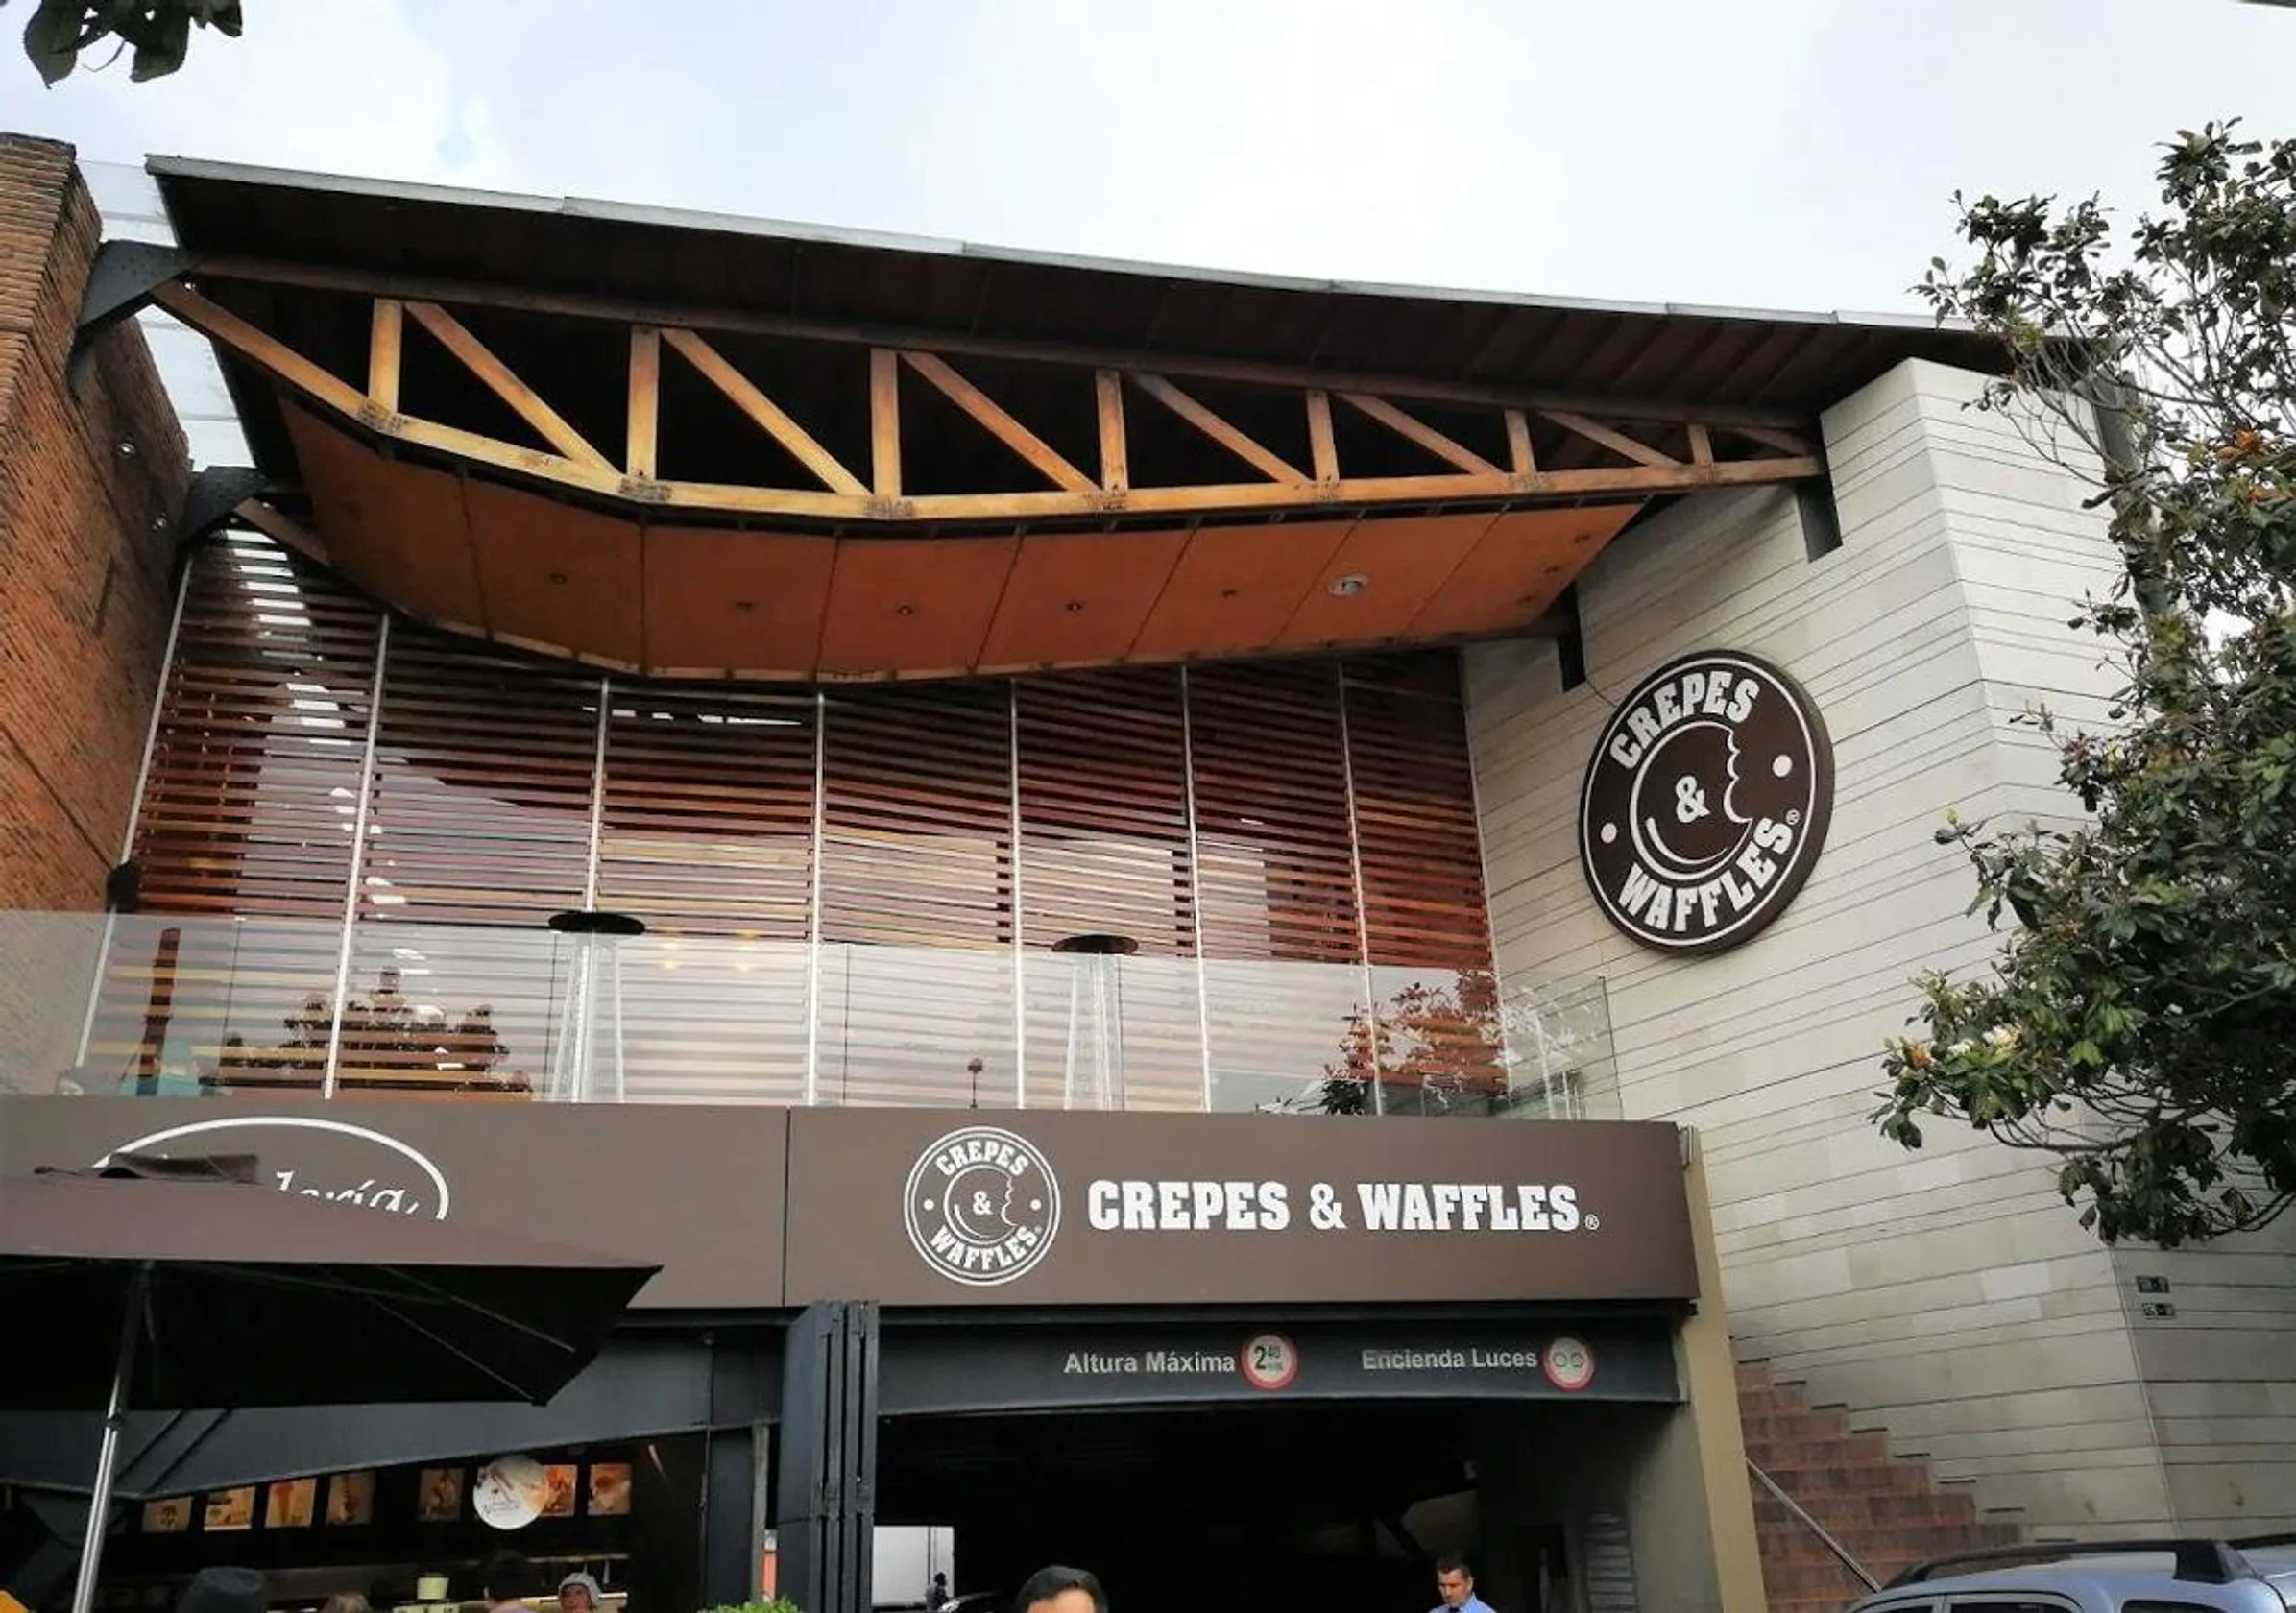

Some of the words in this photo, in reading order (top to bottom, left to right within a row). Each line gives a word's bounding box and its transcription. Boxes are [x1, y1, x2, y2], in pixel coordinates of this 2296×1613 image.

[1609, 671, 1760, 769] CREPES
[1675, 775, 1711, 823] &
[935, 1140, 1029, 1176] CREPES
[972, 1191, 993, 1216] &
[1088, 1180, 1290, 1230] CREPES
[1309, 1183, 1347, 1230] &
[1063, 1352, 1138, 1374] Altura
[1145, 1351, 1236, 1373] Máxima
[1362, 1349, 1465, 1370] Encienda
[1472, 1348, 1537, 1368] Luces
